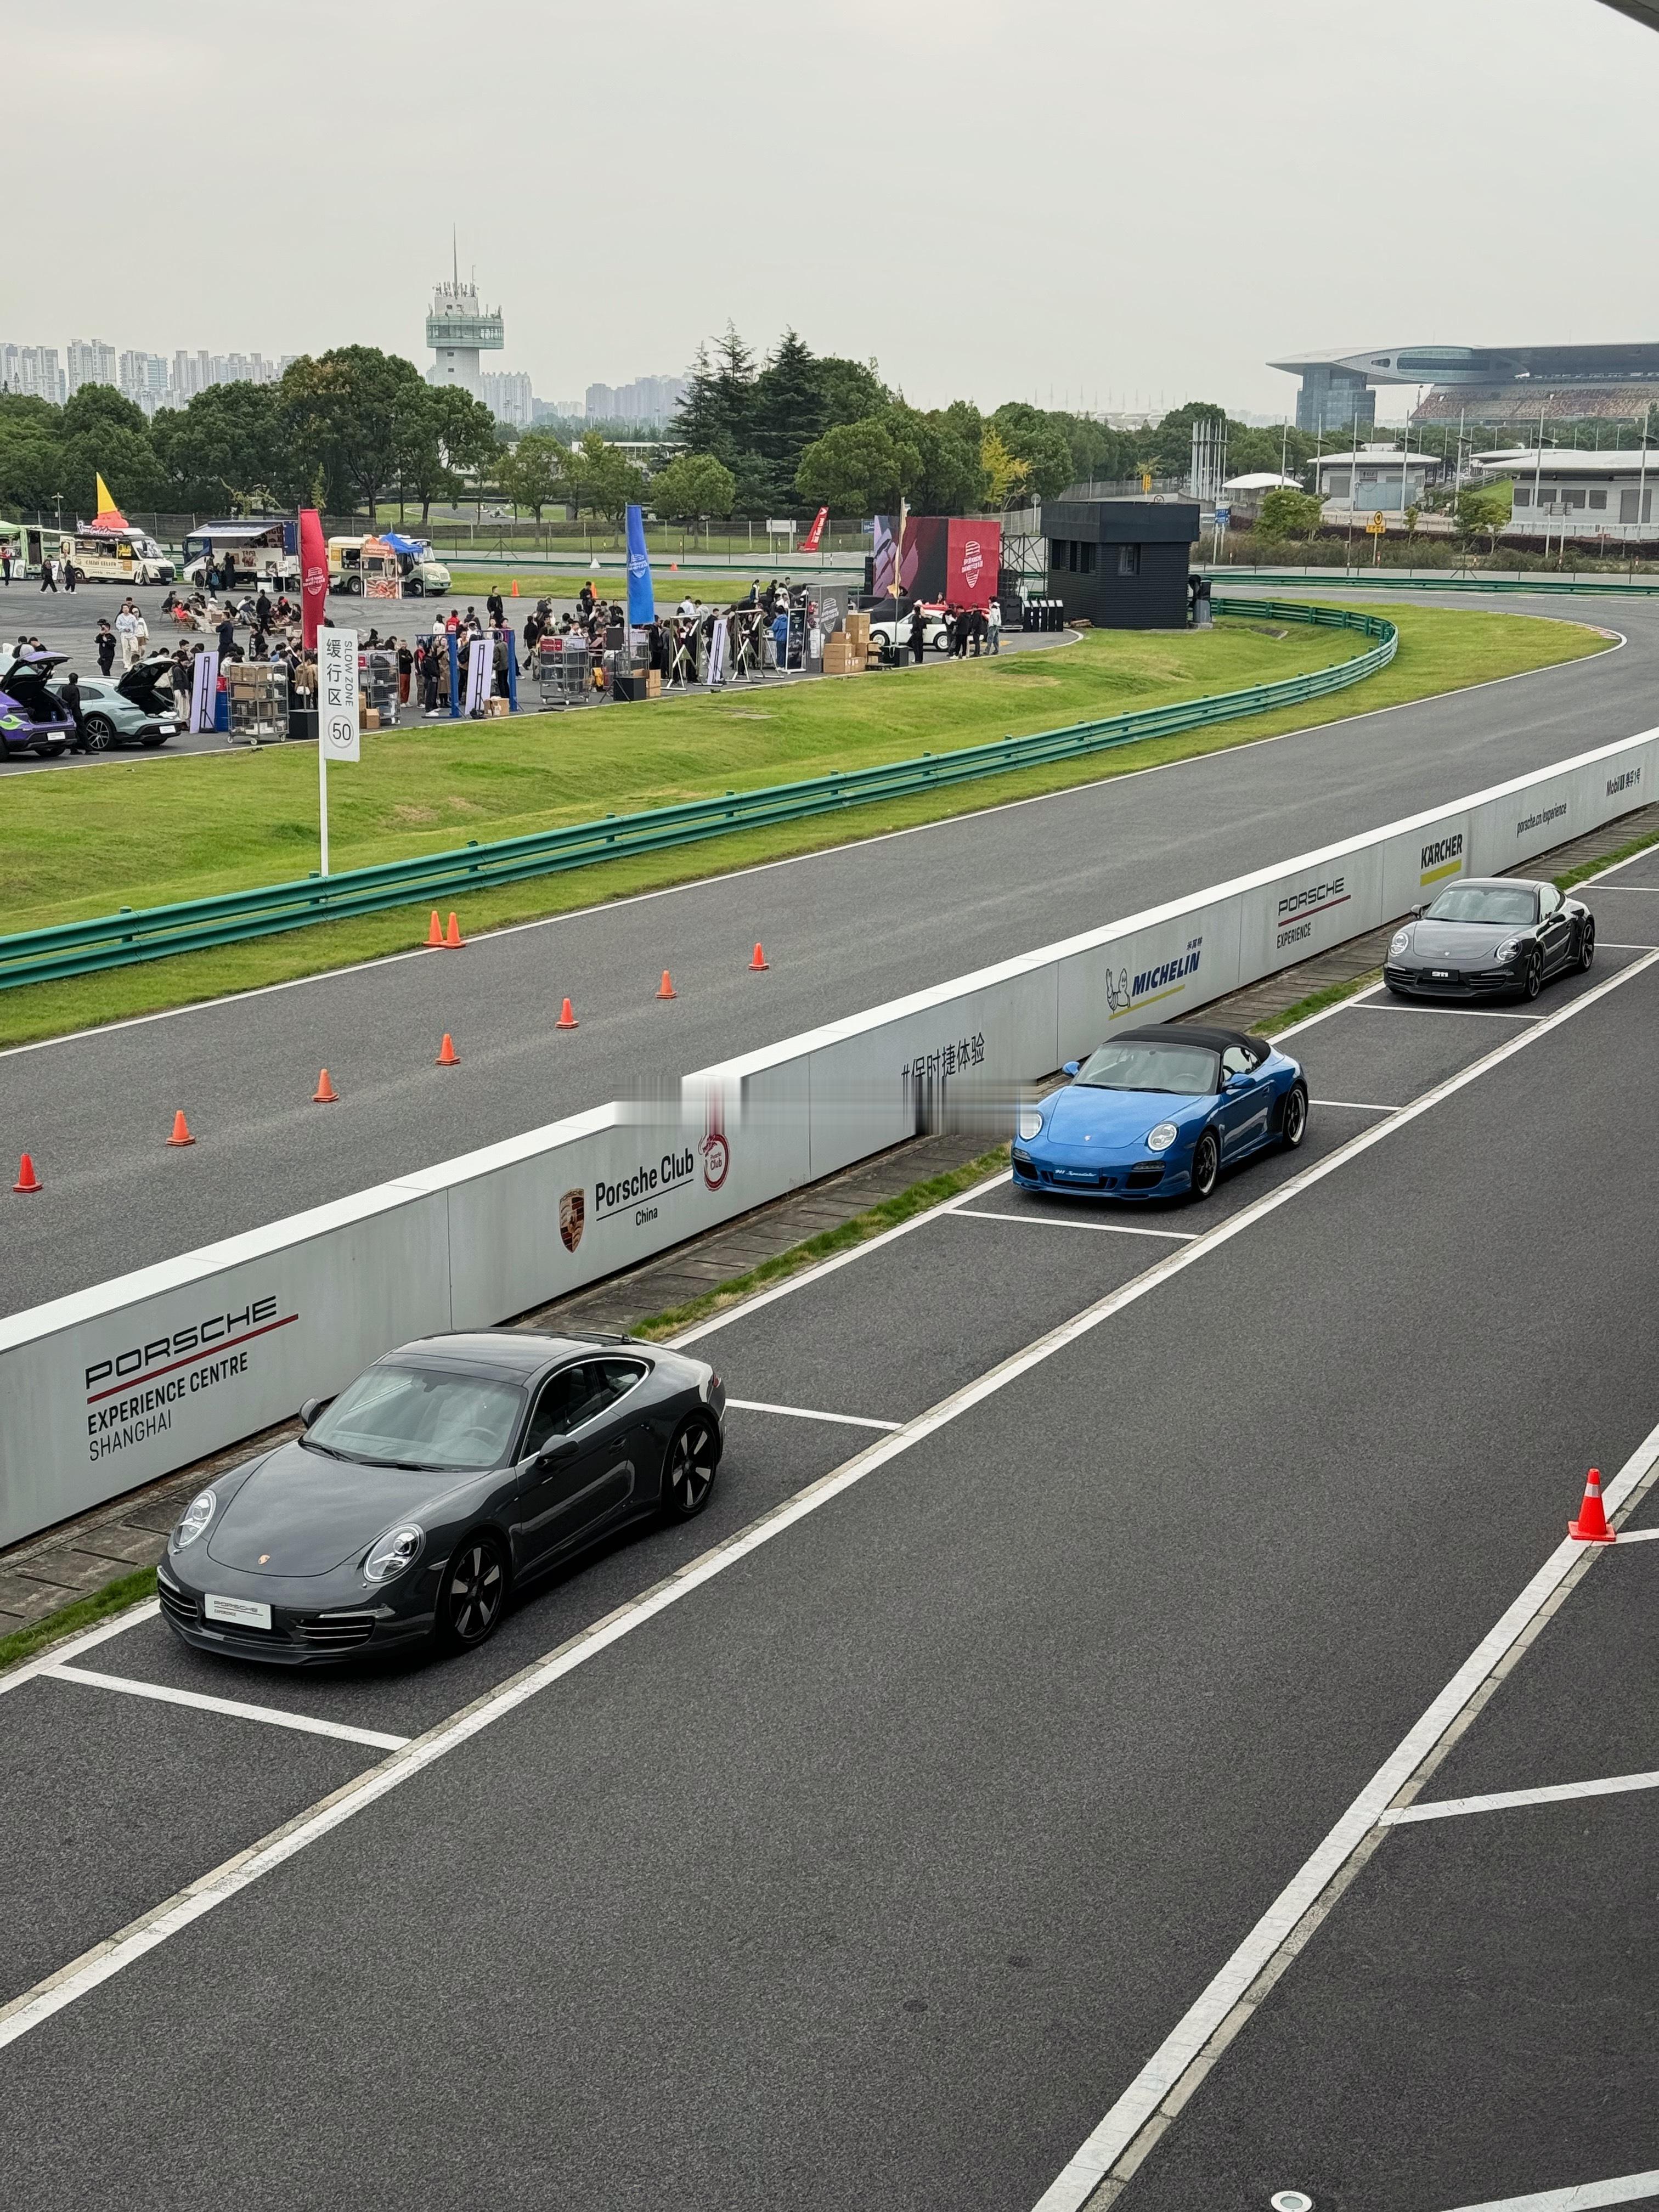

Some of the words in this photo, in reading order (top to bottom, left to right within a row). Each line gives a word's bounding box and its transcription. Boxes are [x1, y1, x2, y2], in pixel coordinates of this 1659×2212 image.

[326, 639, 342, 706] 缓行区
[344, 640, 353, 675] SLOW
[345, 676, 353, 707] ZONE
[332, 723, 351, 741] 50
[1278, 877, 1345, 916] PORSCHE
[1277, 922, 1311, 949] EXPERIENCE
[1131, 950, 1201, 997] MICHELIN
[595, 1166, 657, 1212] Porsche
[661, 1148, 694, 1183] Club
[710, 1158, 722, 1171] Club
[635, 1207, 658, 1226] China
[85, 1295, 276, 1390] PORSCHE
[88, 1377, 185, 1436] EXPERIENCE
[190, 1351, 248, 1392] CENTRE
[89, 1409, 171, 1461] SHANGHAI
[213, 1600, 258, 1613] PORSCHE
